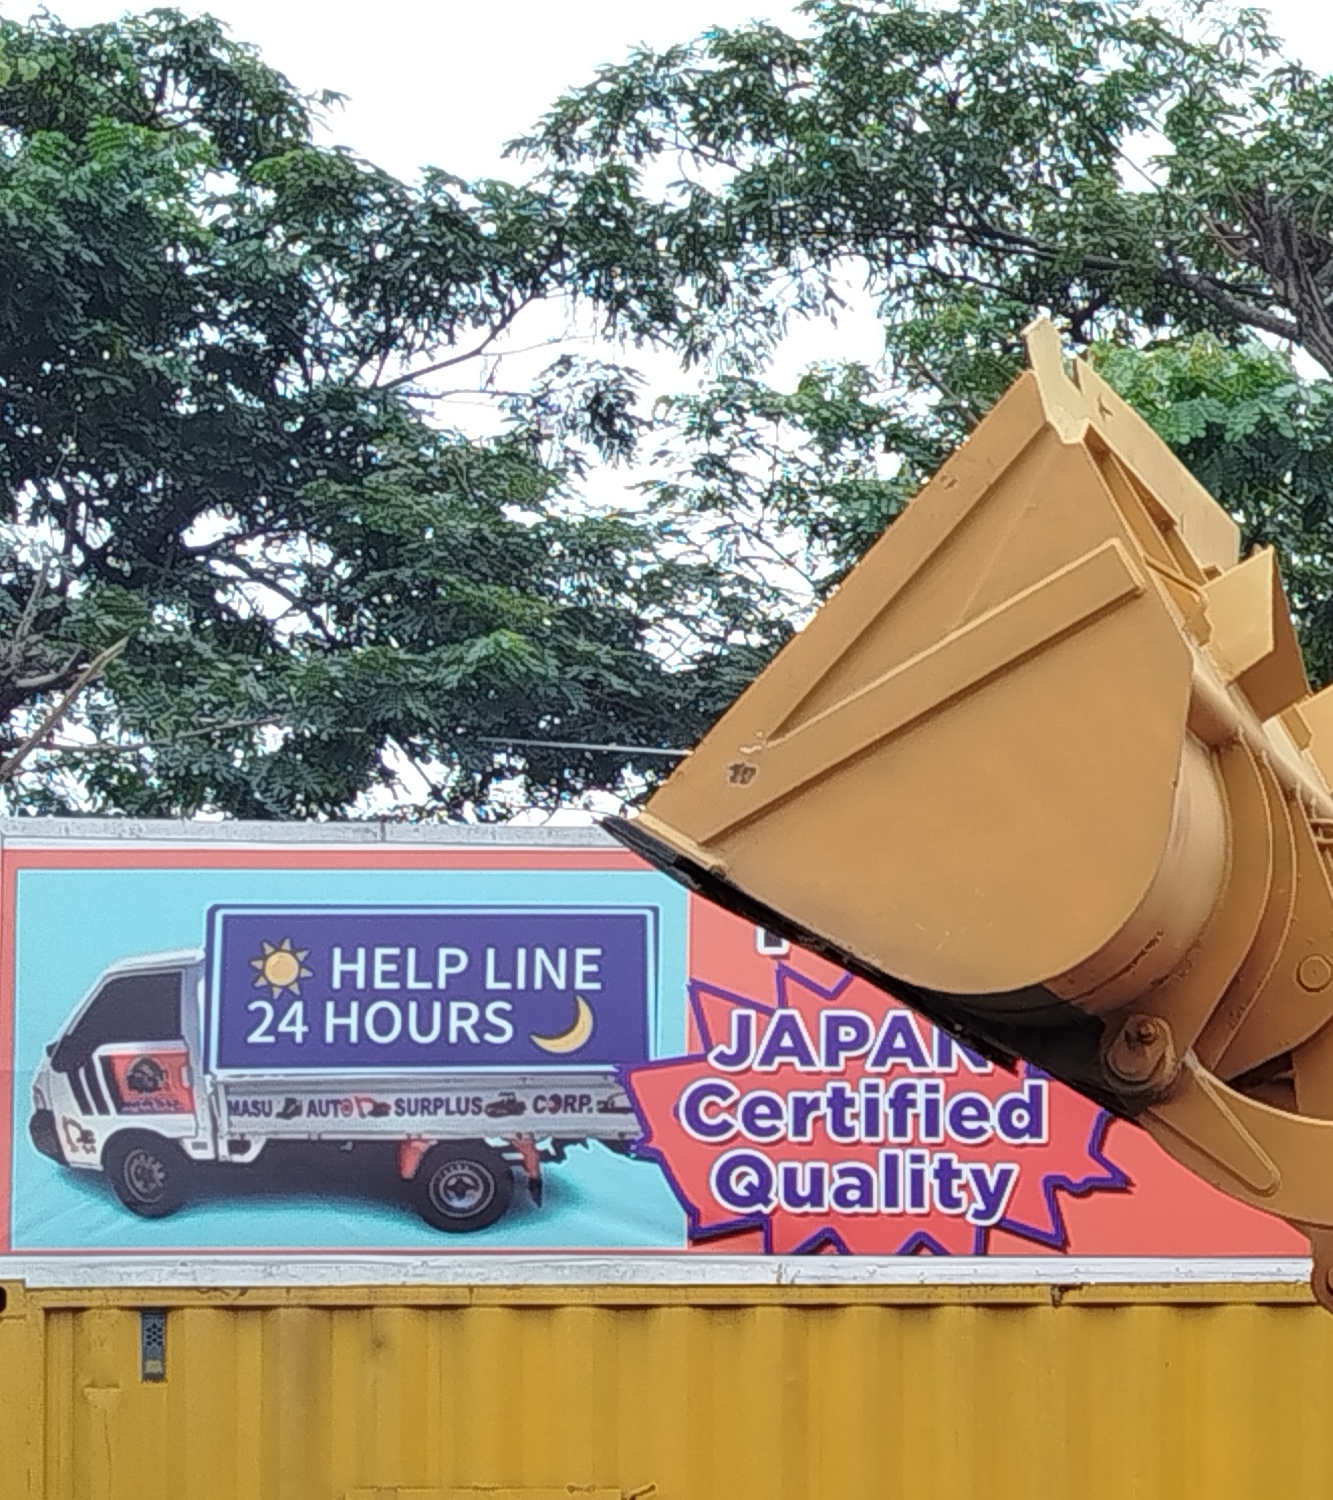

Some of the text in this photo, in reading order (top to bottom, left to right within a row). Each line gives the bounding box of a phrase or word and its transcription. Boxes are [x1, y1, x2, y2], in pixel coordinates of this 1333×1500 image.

[332, 947, 602, 990] HELP LINE
[246, 1000, 513, 1044] 24 HOURS
[229, 1094, 593, 1118] MASU AUTO SURPLUS CORP.
[678, 1077, 1050, 1144] Certified
[710, 1150, 1019, 1226] Quality
